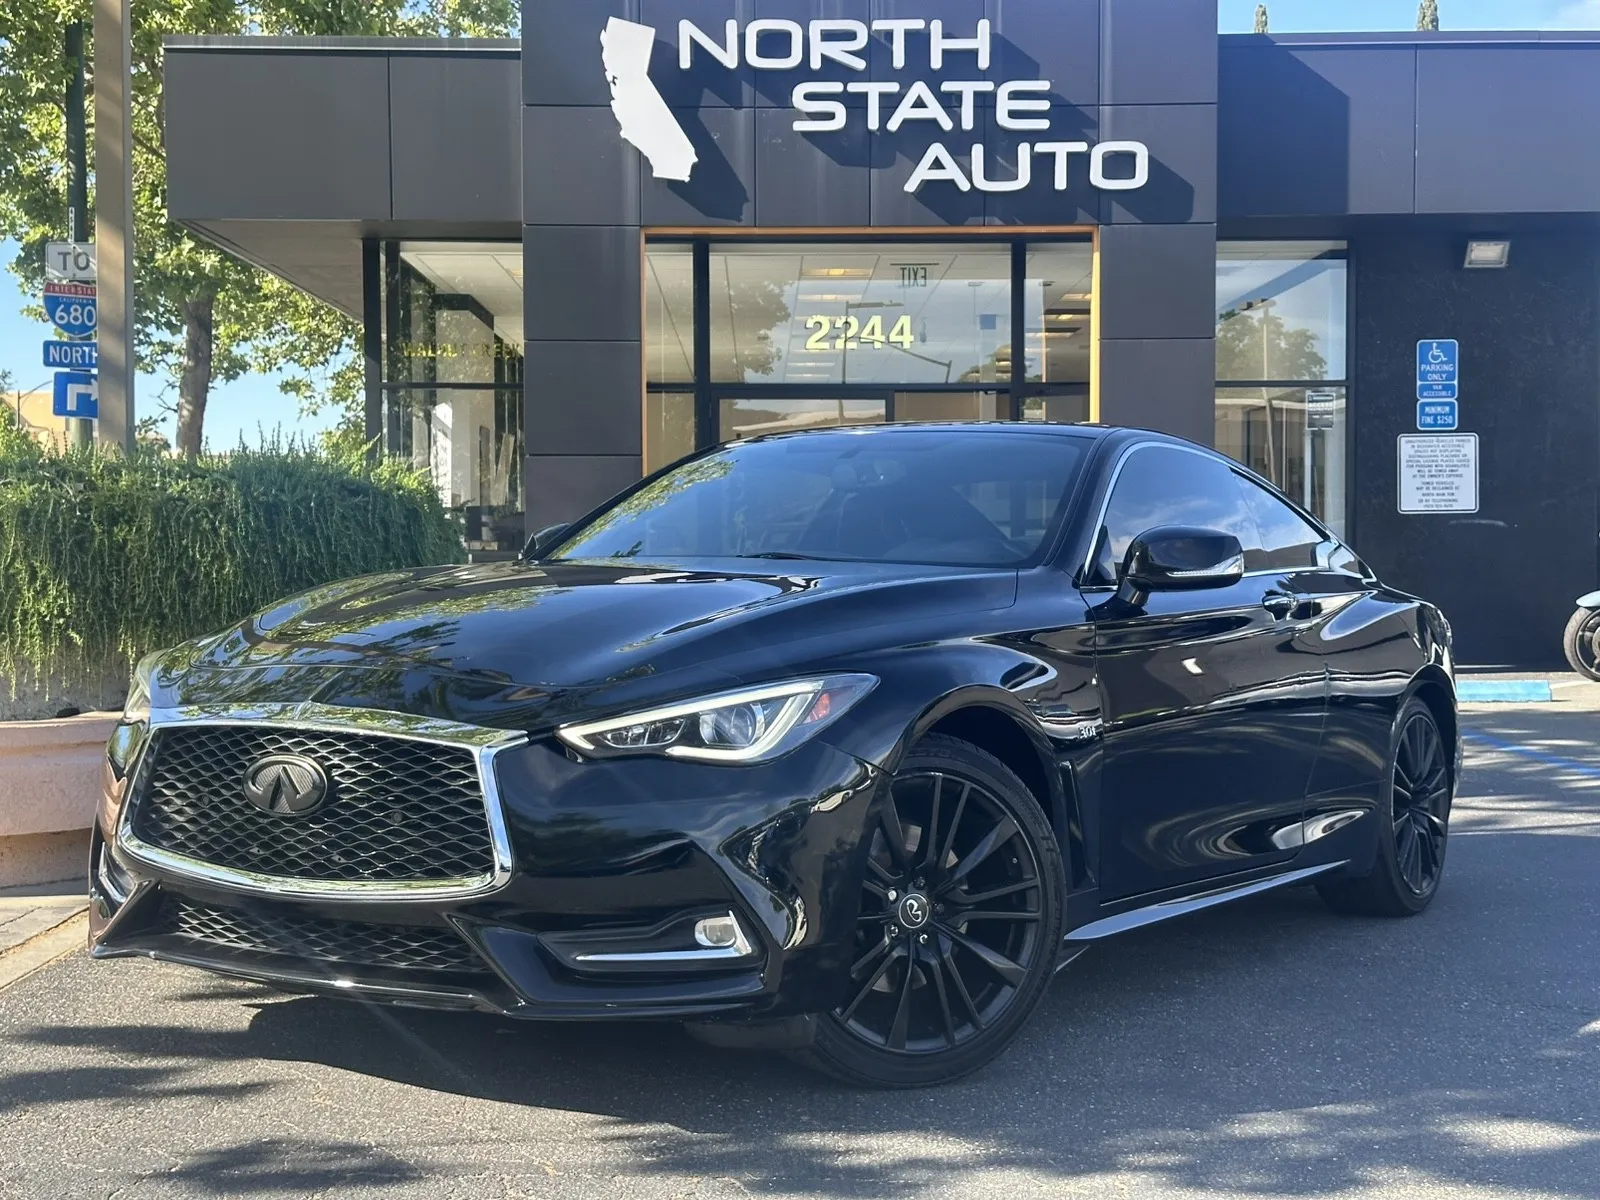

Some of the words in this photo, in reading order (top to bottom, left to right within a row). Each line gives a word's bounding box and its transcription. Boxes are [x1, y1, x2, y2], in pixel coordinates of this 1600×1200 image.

[678, 18, 991, 71] NORTH
[791, 80, 1051, 132] STATE
[903, 141, 1149, 193] AUTO
[57, 251, 90, 271] TO
[50, 284, 96, 295] INTERSTAT
[54, 304, 97, 327] 680
[804, 315, 915, 350] 2244
[1420, 364, 1454, 372] PARKING
[1427, 373, 1448, 381] ONLY
